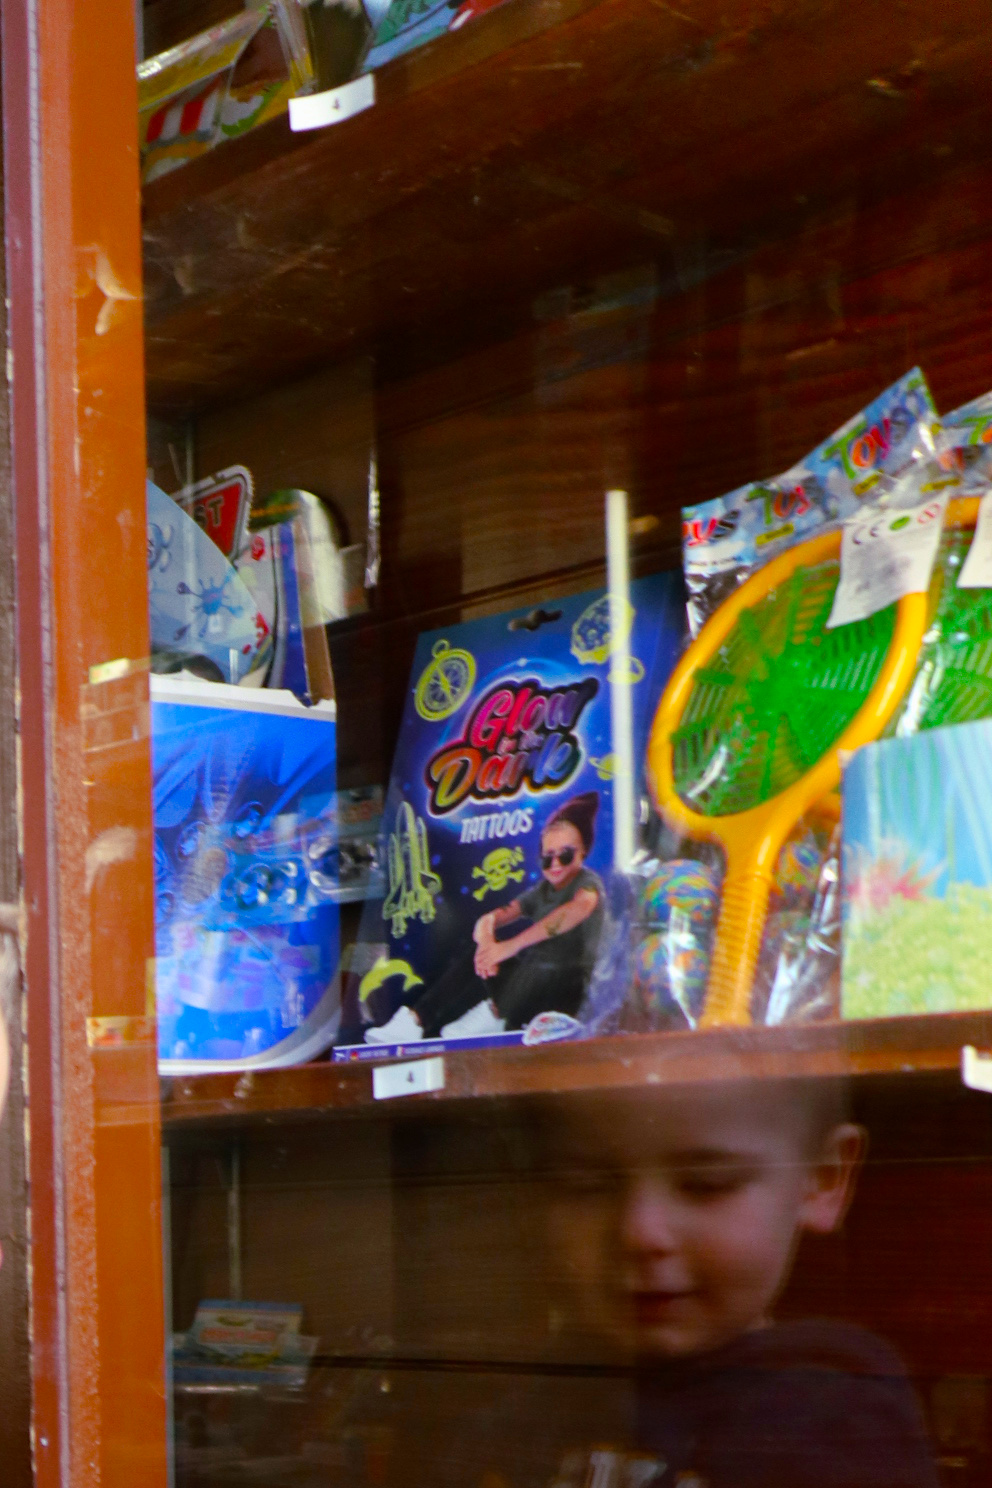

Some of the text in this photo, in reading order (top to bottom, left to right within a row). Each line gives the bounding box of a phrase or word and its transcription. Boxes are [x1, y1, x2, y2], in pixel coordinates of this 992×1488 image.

[470, 685, 592, 752] Glow
[430, 732, 574, 808] Dark
[460, 806, 534, 844] TATTOOS
